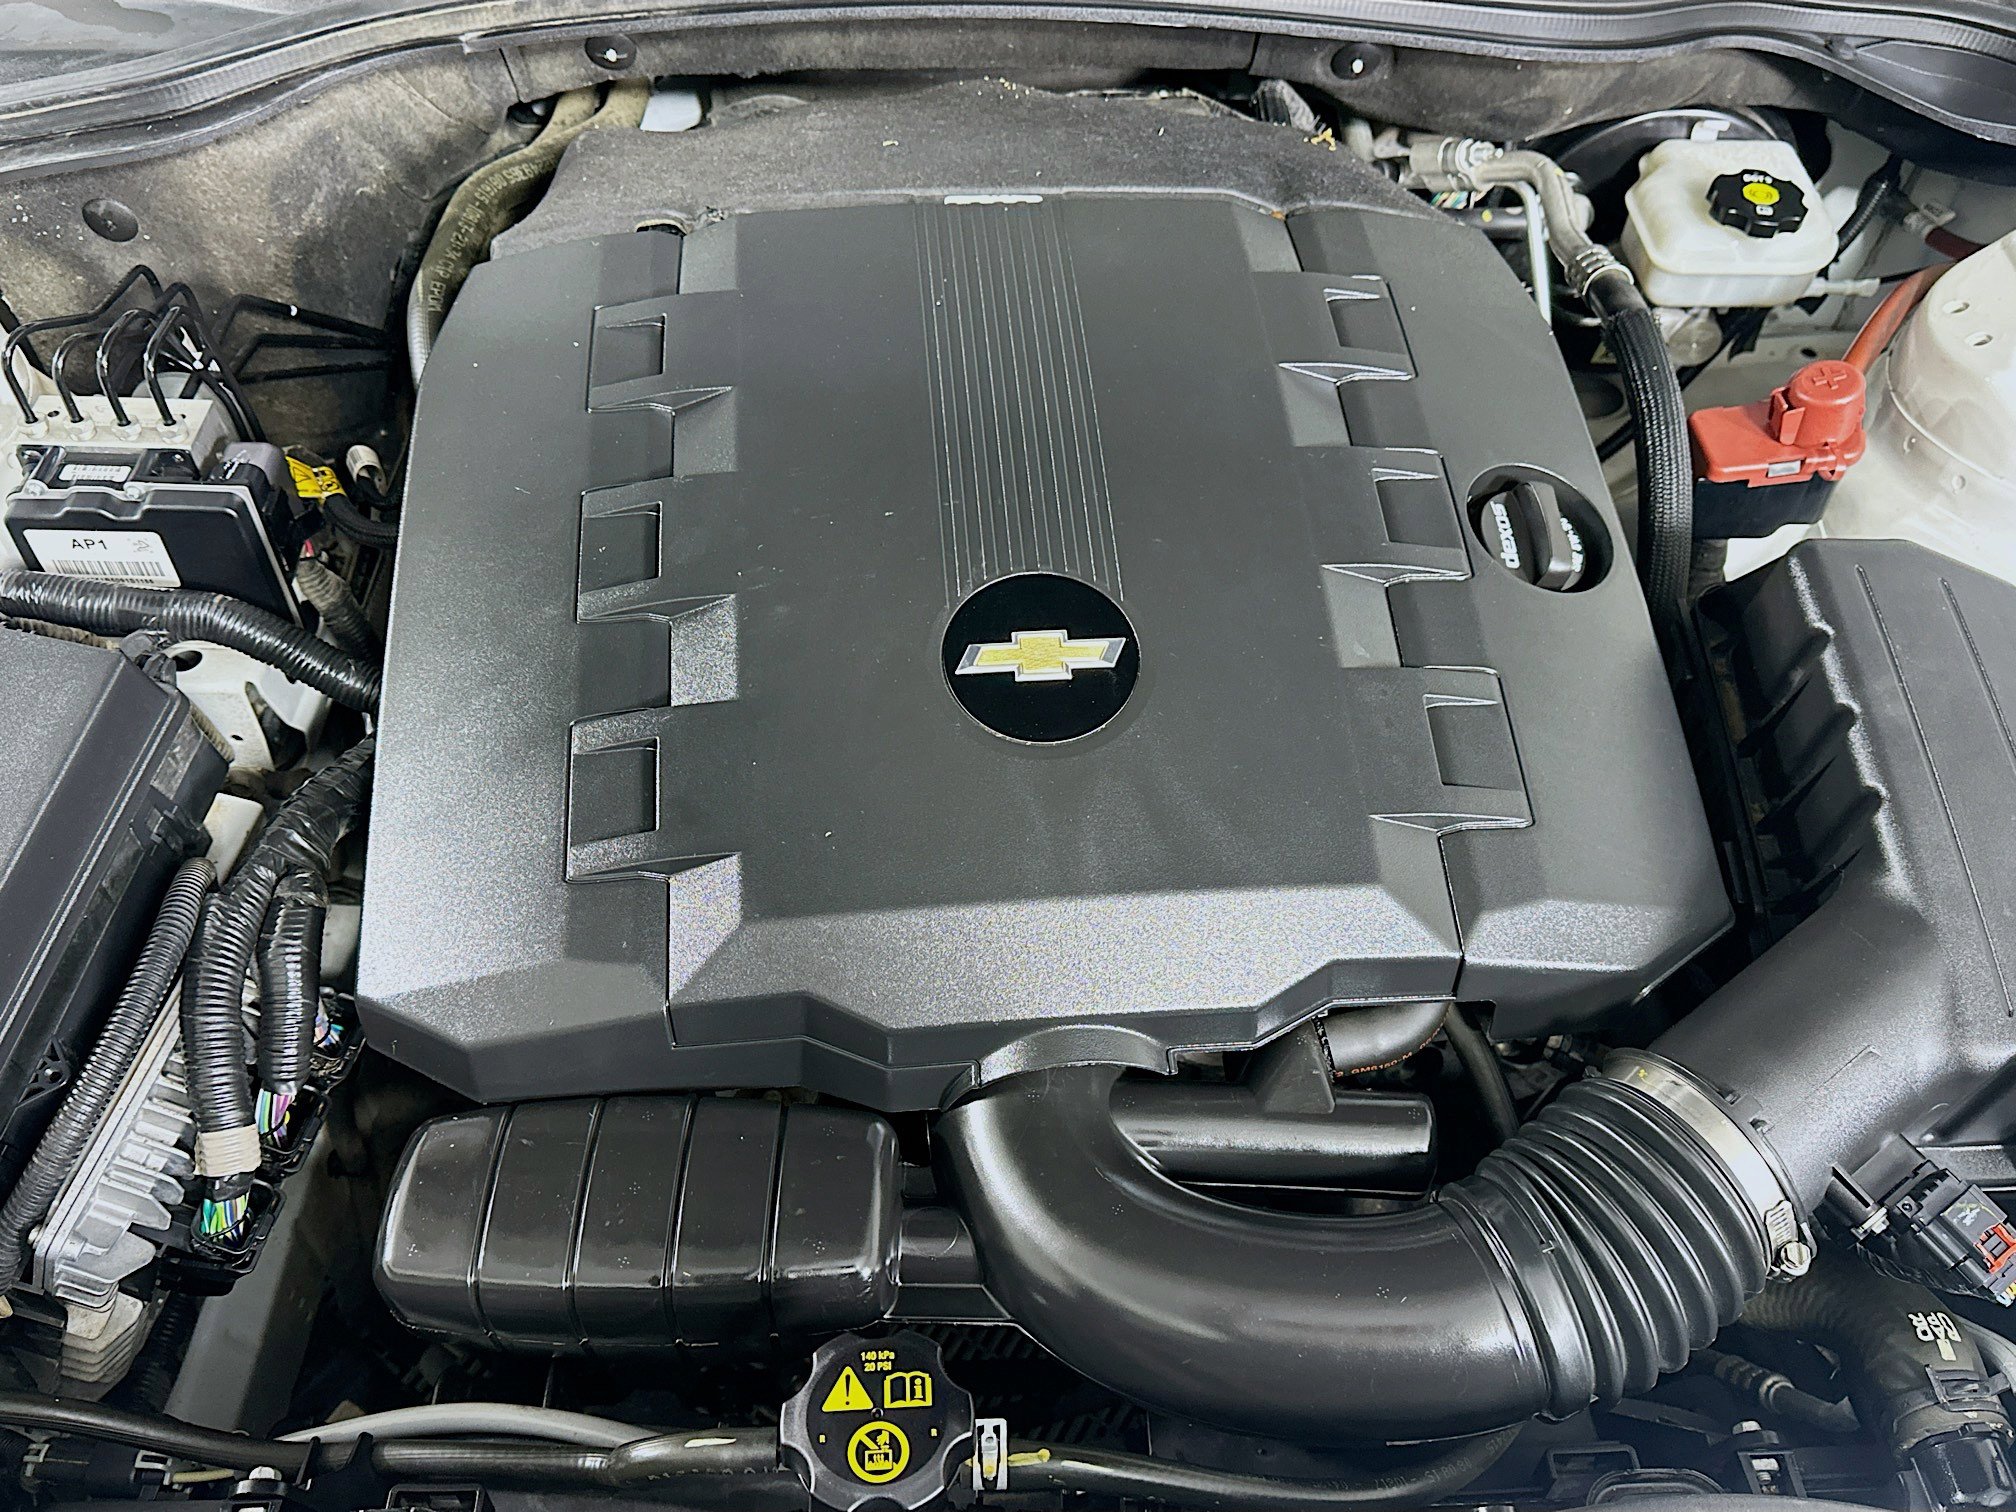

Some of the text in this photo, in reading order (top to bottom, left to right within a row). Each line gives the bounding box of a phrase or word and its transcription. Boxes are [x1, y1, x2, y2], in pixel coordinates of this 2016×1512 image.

[1490, 501, 1520, 569] dexos
[71, 538, 108, 550] AP1
[860, 1351, 877, 1361] 140
[864, 1361, 892, 1372] 20 PSI
